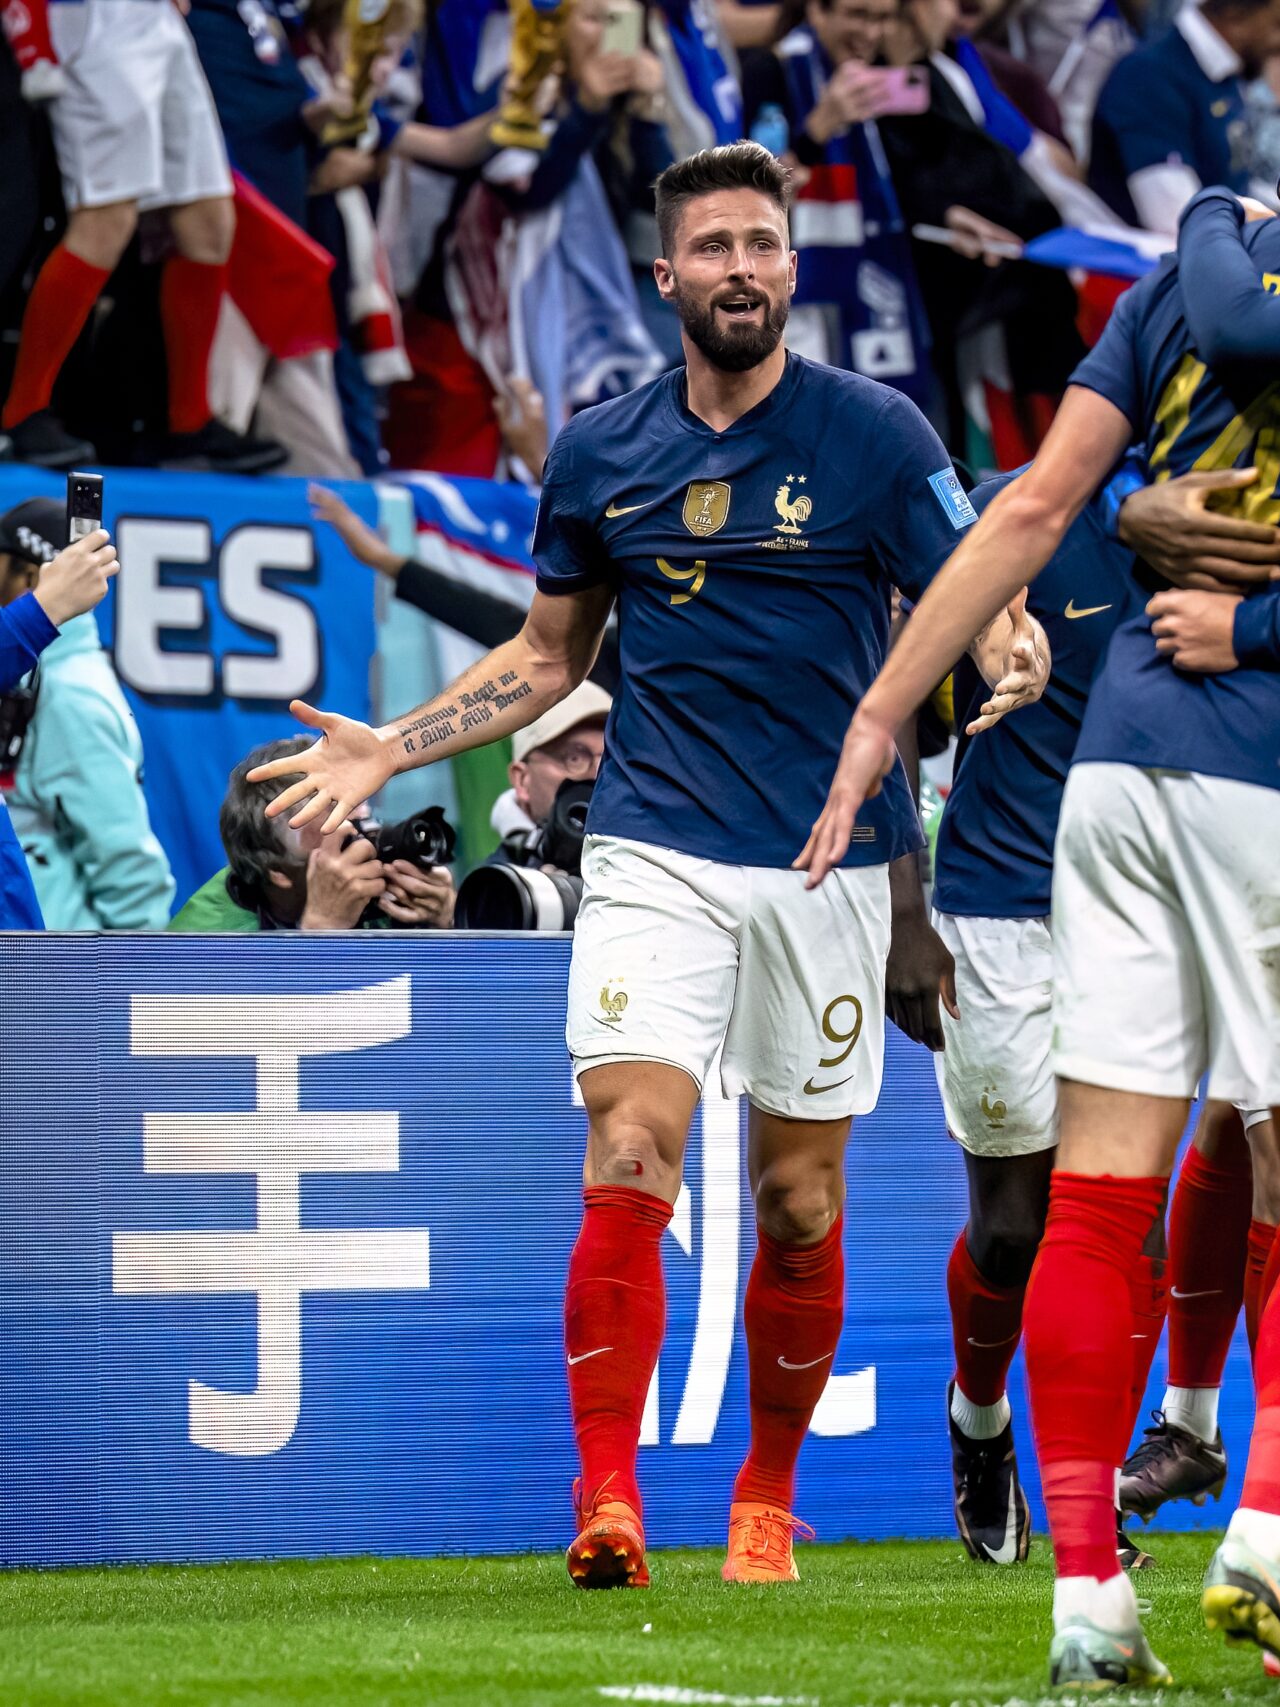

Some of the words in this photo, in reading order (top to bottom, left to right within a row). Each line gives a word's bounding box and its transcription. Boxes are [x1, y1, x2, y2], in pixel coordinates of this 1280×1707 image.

[694, 515, 712, 525] FIFA
[498, 670, 519, 687] me
[819, 995, 862, 1067] 9
